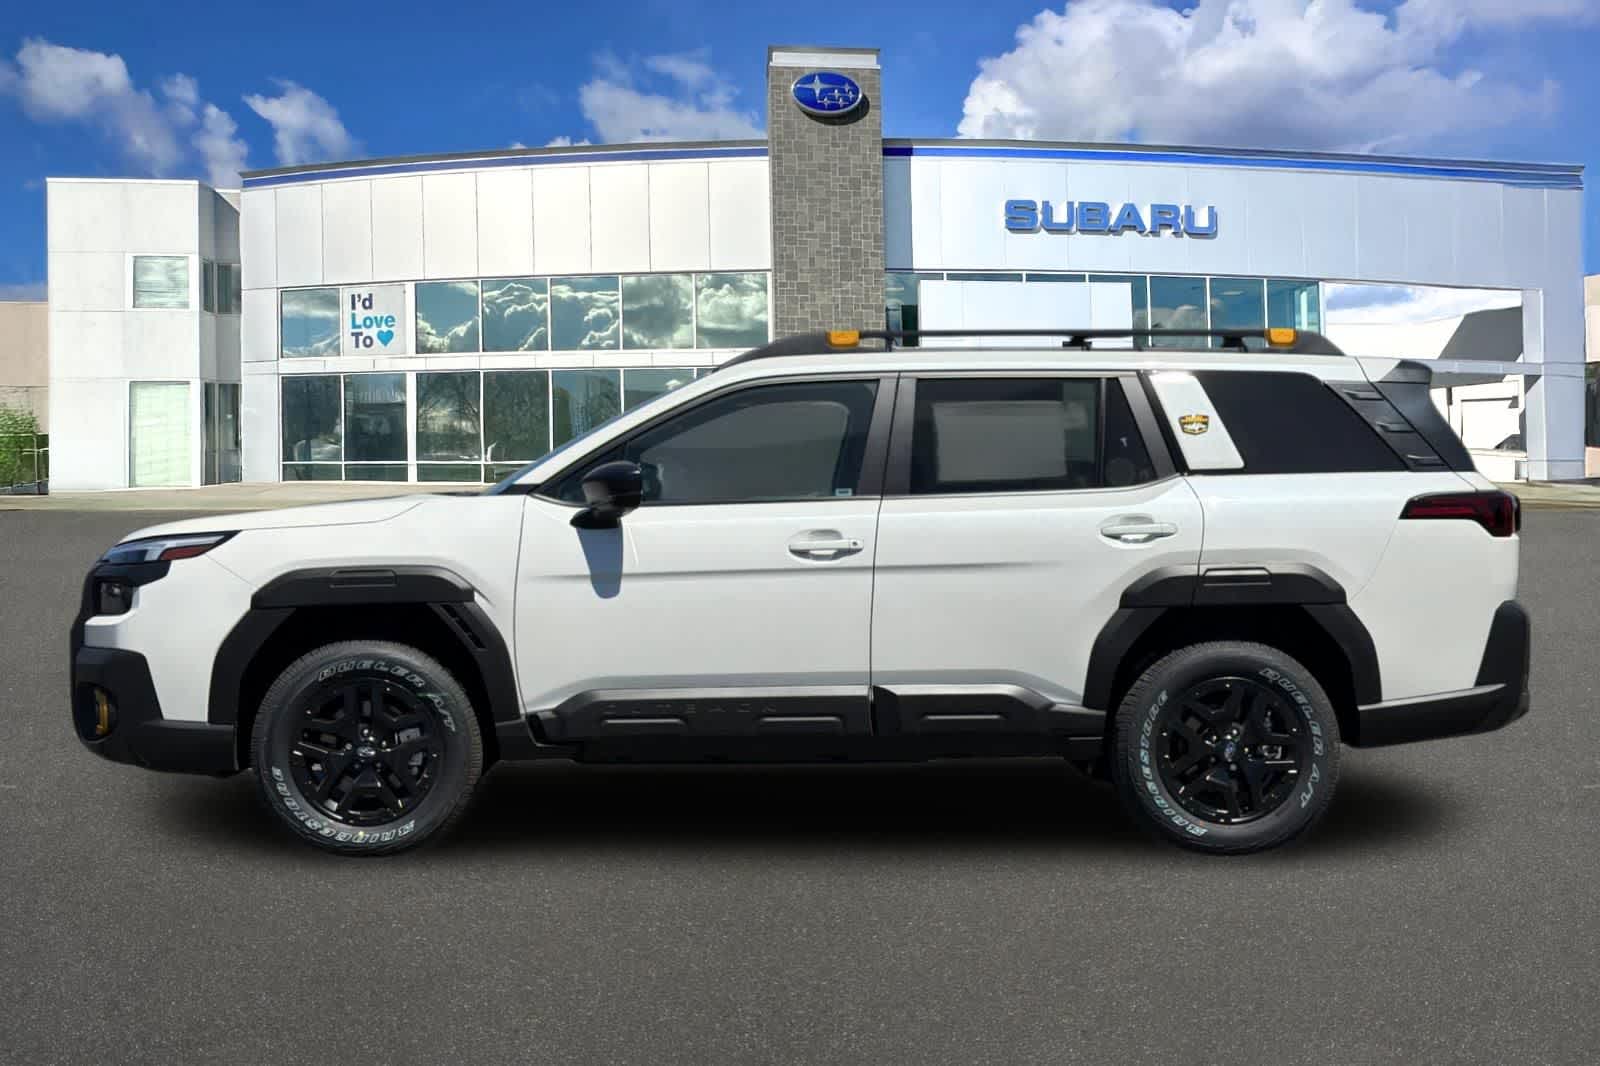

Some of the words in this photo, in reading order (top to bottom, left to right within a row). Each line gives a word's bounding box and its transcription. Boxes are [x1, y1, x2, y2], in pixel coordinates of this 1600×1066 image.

[1004, 199, 1218, 239] SUBARU
[350, 293, 373, 311] I'd
[351, 312, 396, 330] Love
[350, 331, 374, 349] To
